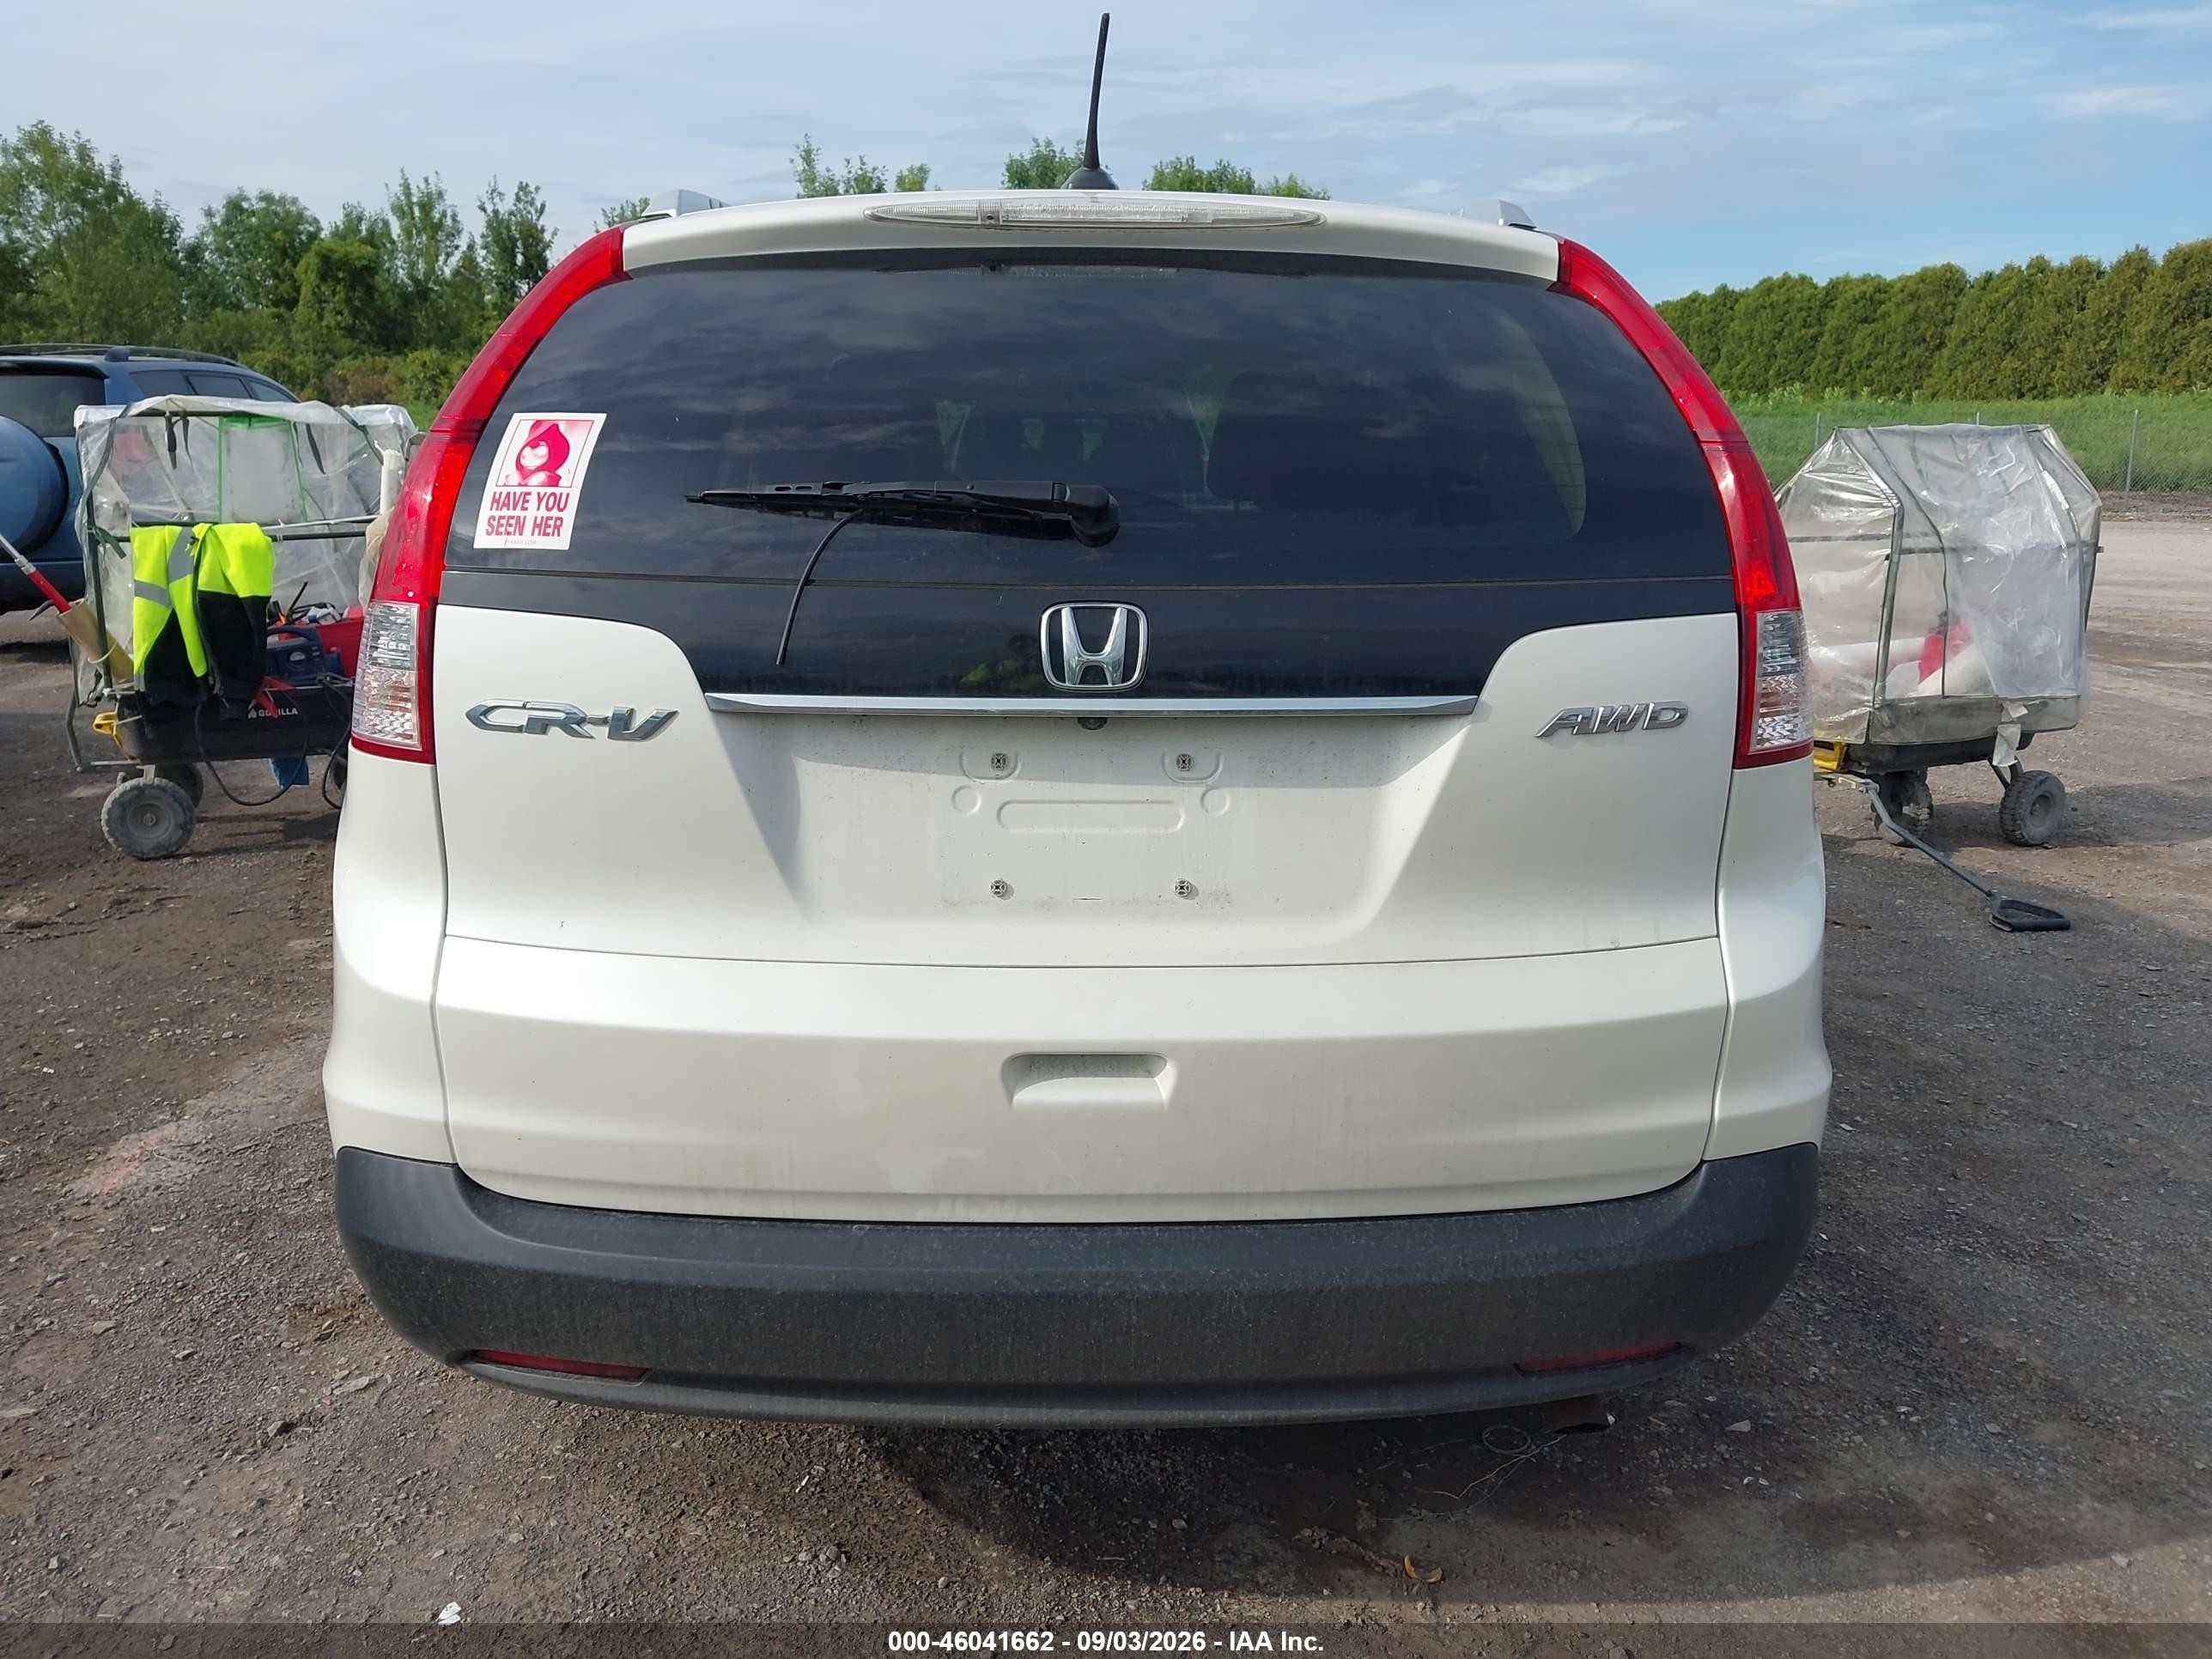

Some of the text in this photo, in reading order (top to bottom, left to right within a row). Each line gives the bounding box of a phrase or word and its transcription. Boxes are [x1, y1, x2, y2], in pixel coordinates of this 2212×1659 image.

[489, 491, 570, 512] HAVE YOU
[485, 515, 563, 537] SEEN HER
[258, 708, 299, 718] GOILLA
[465, 698, 680, 742] CR-V
[1533, 700, 1689, 738] AWD
